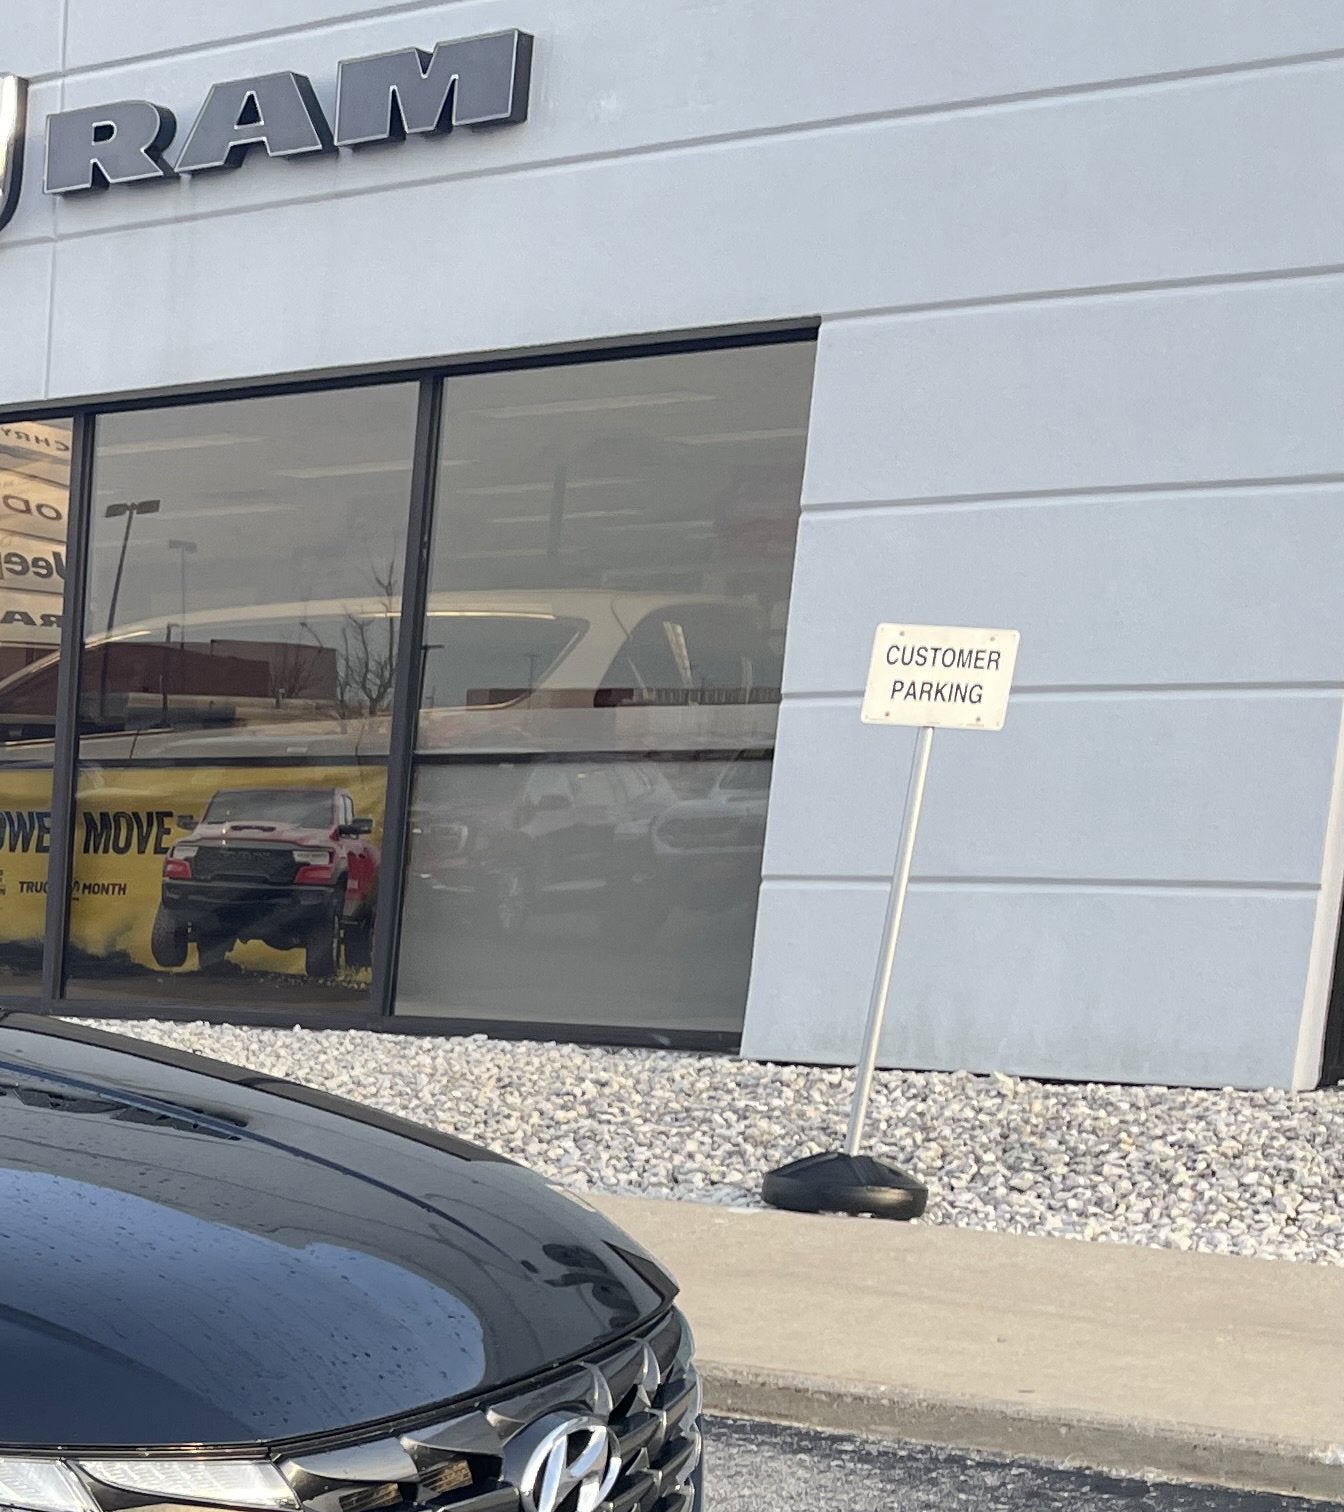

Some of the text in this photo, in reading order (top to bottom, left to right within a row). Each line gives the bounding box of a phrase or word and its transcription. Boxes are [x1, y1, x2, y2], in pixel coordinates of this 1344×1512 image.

[43, 28, 526, 195] RAM
[886, 645, 1001, 671] CUSTOMER
[890, 680, 983, 704] PARKING
[82, 810, 174, 856] MOVE
[19, 881, 127, 896] TRUC MONTH
